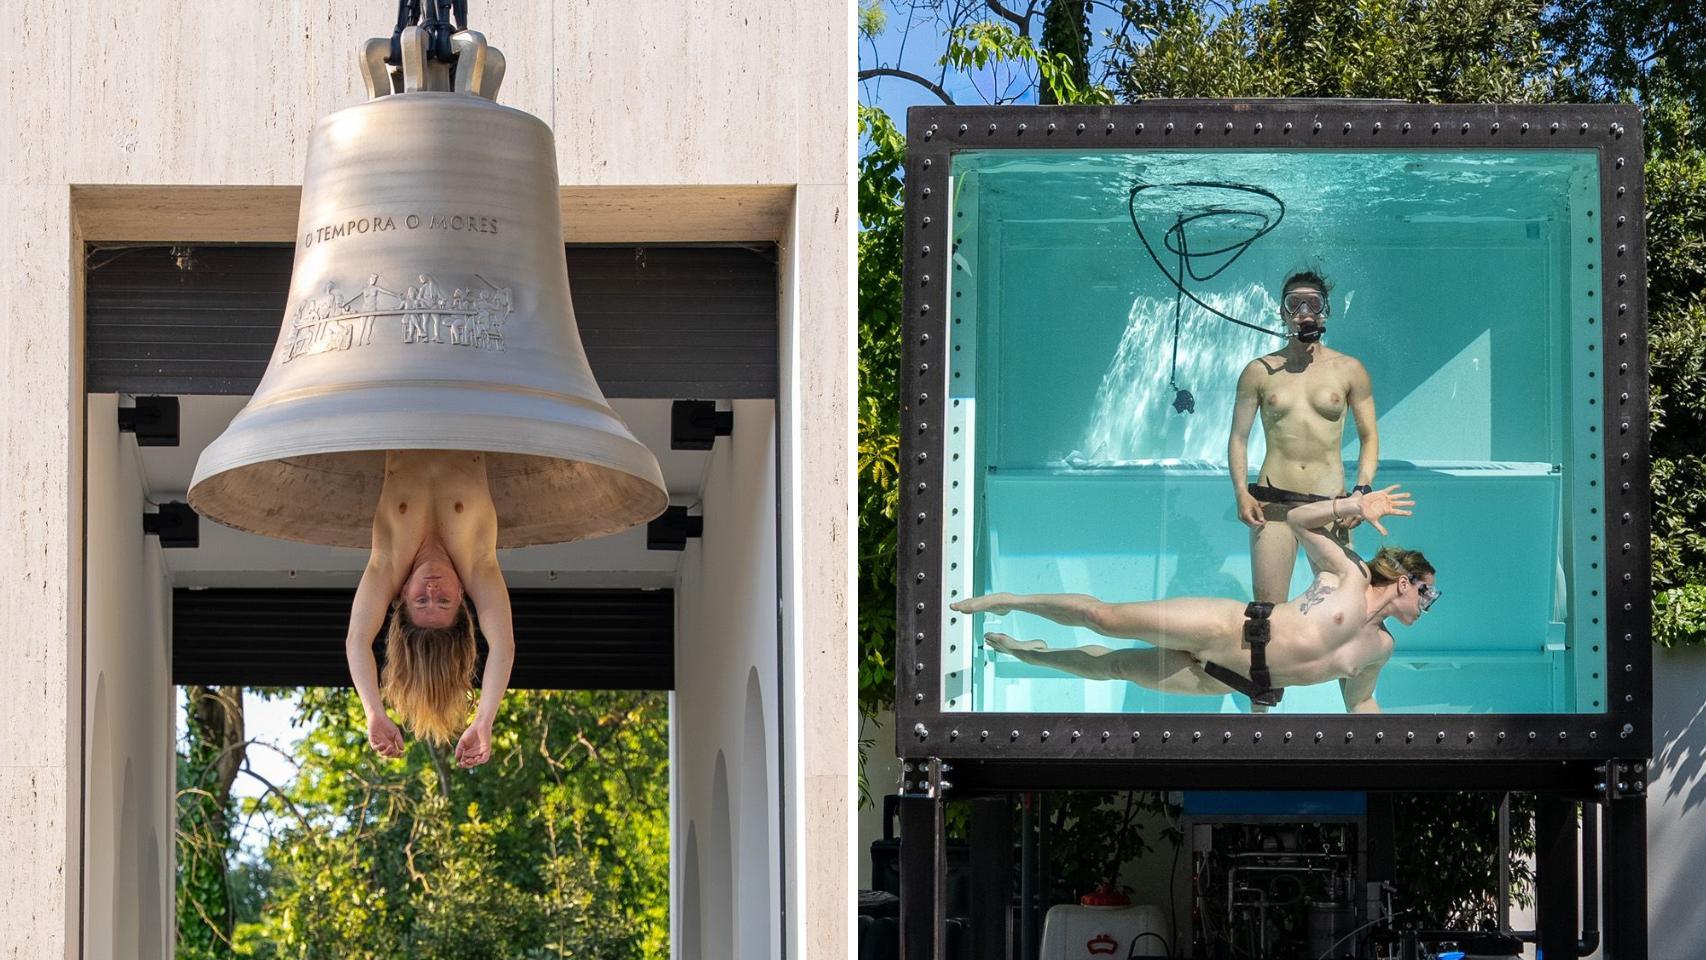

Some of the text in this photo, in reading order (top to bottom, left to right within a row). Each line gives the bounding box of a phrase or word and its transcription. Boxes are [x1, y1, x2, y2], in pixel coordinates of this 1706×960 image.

[305, 214, 498, 248] O TEMPORA O MORES
